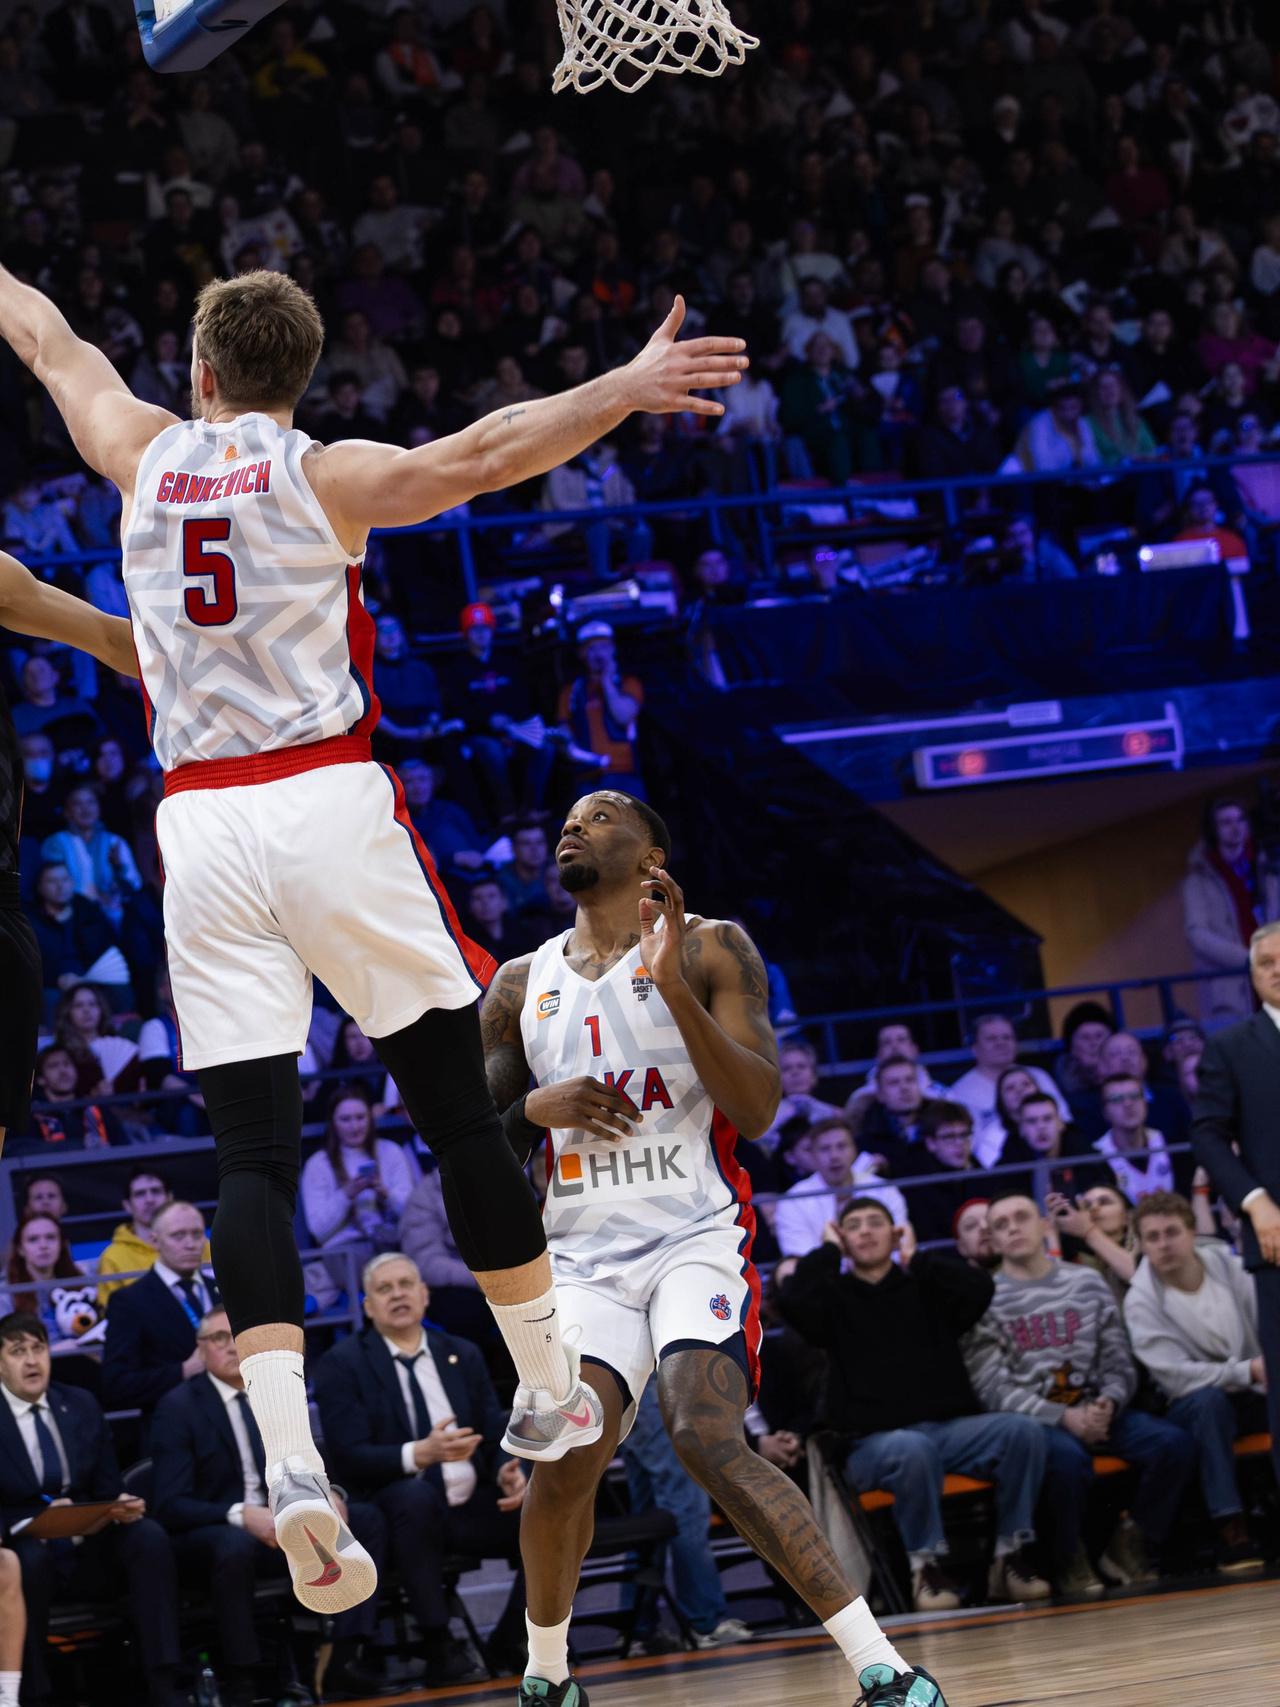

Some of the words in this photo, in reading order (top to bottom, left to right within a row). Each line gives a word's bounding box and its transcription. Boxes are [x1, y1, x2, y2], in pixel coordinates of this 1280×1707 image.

[156, 459, 272, 504] GANKEVICH
[183, 517, 238, 627] 5
[631, 976, 655, 986] WINLIN
[632, 985, 654, 994] BASKET
[541, 997, 560, 1011] WIN
[637, 993, 649, 1002] CUP
[584, 1014, 602, 1058] 1
[588, 1067, 675, 1113] KA
[545, 1332, 552, 1343] 5
[1009, 1308, 1081, 1352] HELP
